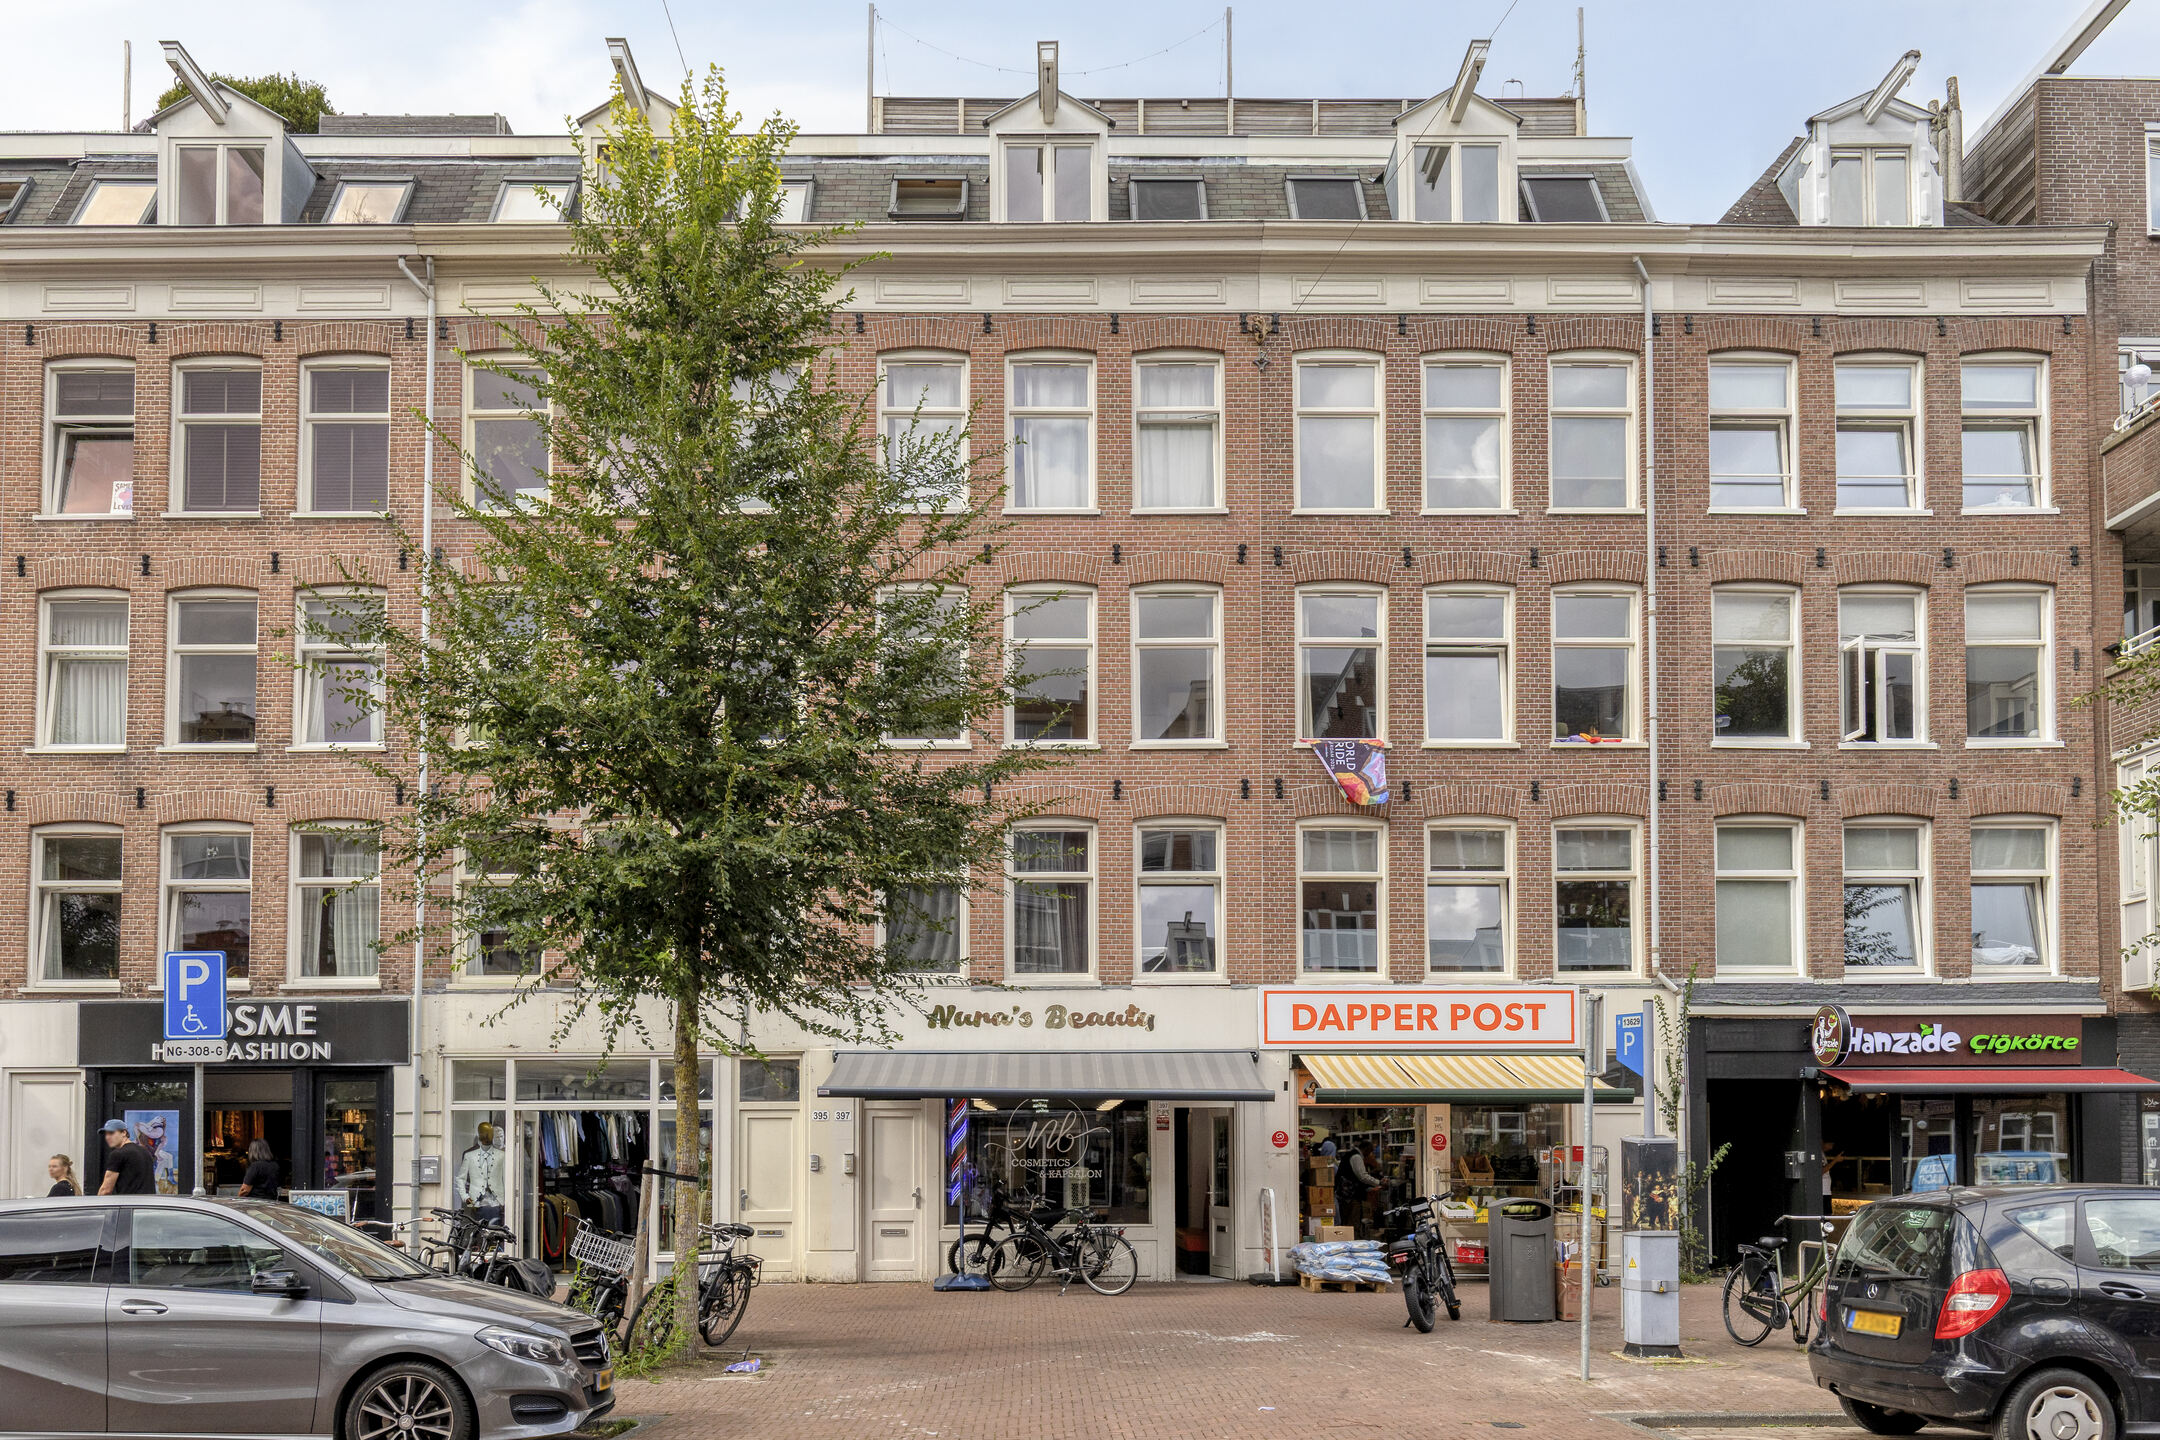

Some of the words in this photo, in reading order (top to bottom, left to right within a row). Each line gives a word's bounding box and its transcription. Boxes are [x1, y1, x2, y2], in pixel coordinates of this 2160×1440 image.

[1335, 742, 1346, 765] RIDE
[1345, 741, 1356, 770] ORLD
[179, 959, 210, 1001] P
[227, 1005, 317, 1036] SME
[1045, 1003, 1155, 1032] Beauty
[1292, 1003, 1438, 1031] DAPPER
[1450, 1002, 1546, 1031] POST
[1623, 1018, 1640, 1026] 13629
[1624, 1032, 1635, 1056] P
[1850, 1023, 1961, 1054] Hanzade
[166, 1046, 223, 1056] NG-308-G
[227, 1042, 331, 1060] ASHION
[813, 1111, 828, 1120] 395
[836, 1111, 850, 1120] 397
[1011, 1159, 1071, 1167] COSMETICS
[1040, 1170, 1047, 1178] &
[1049, 1170, 1102, 1178] KAPSALON
